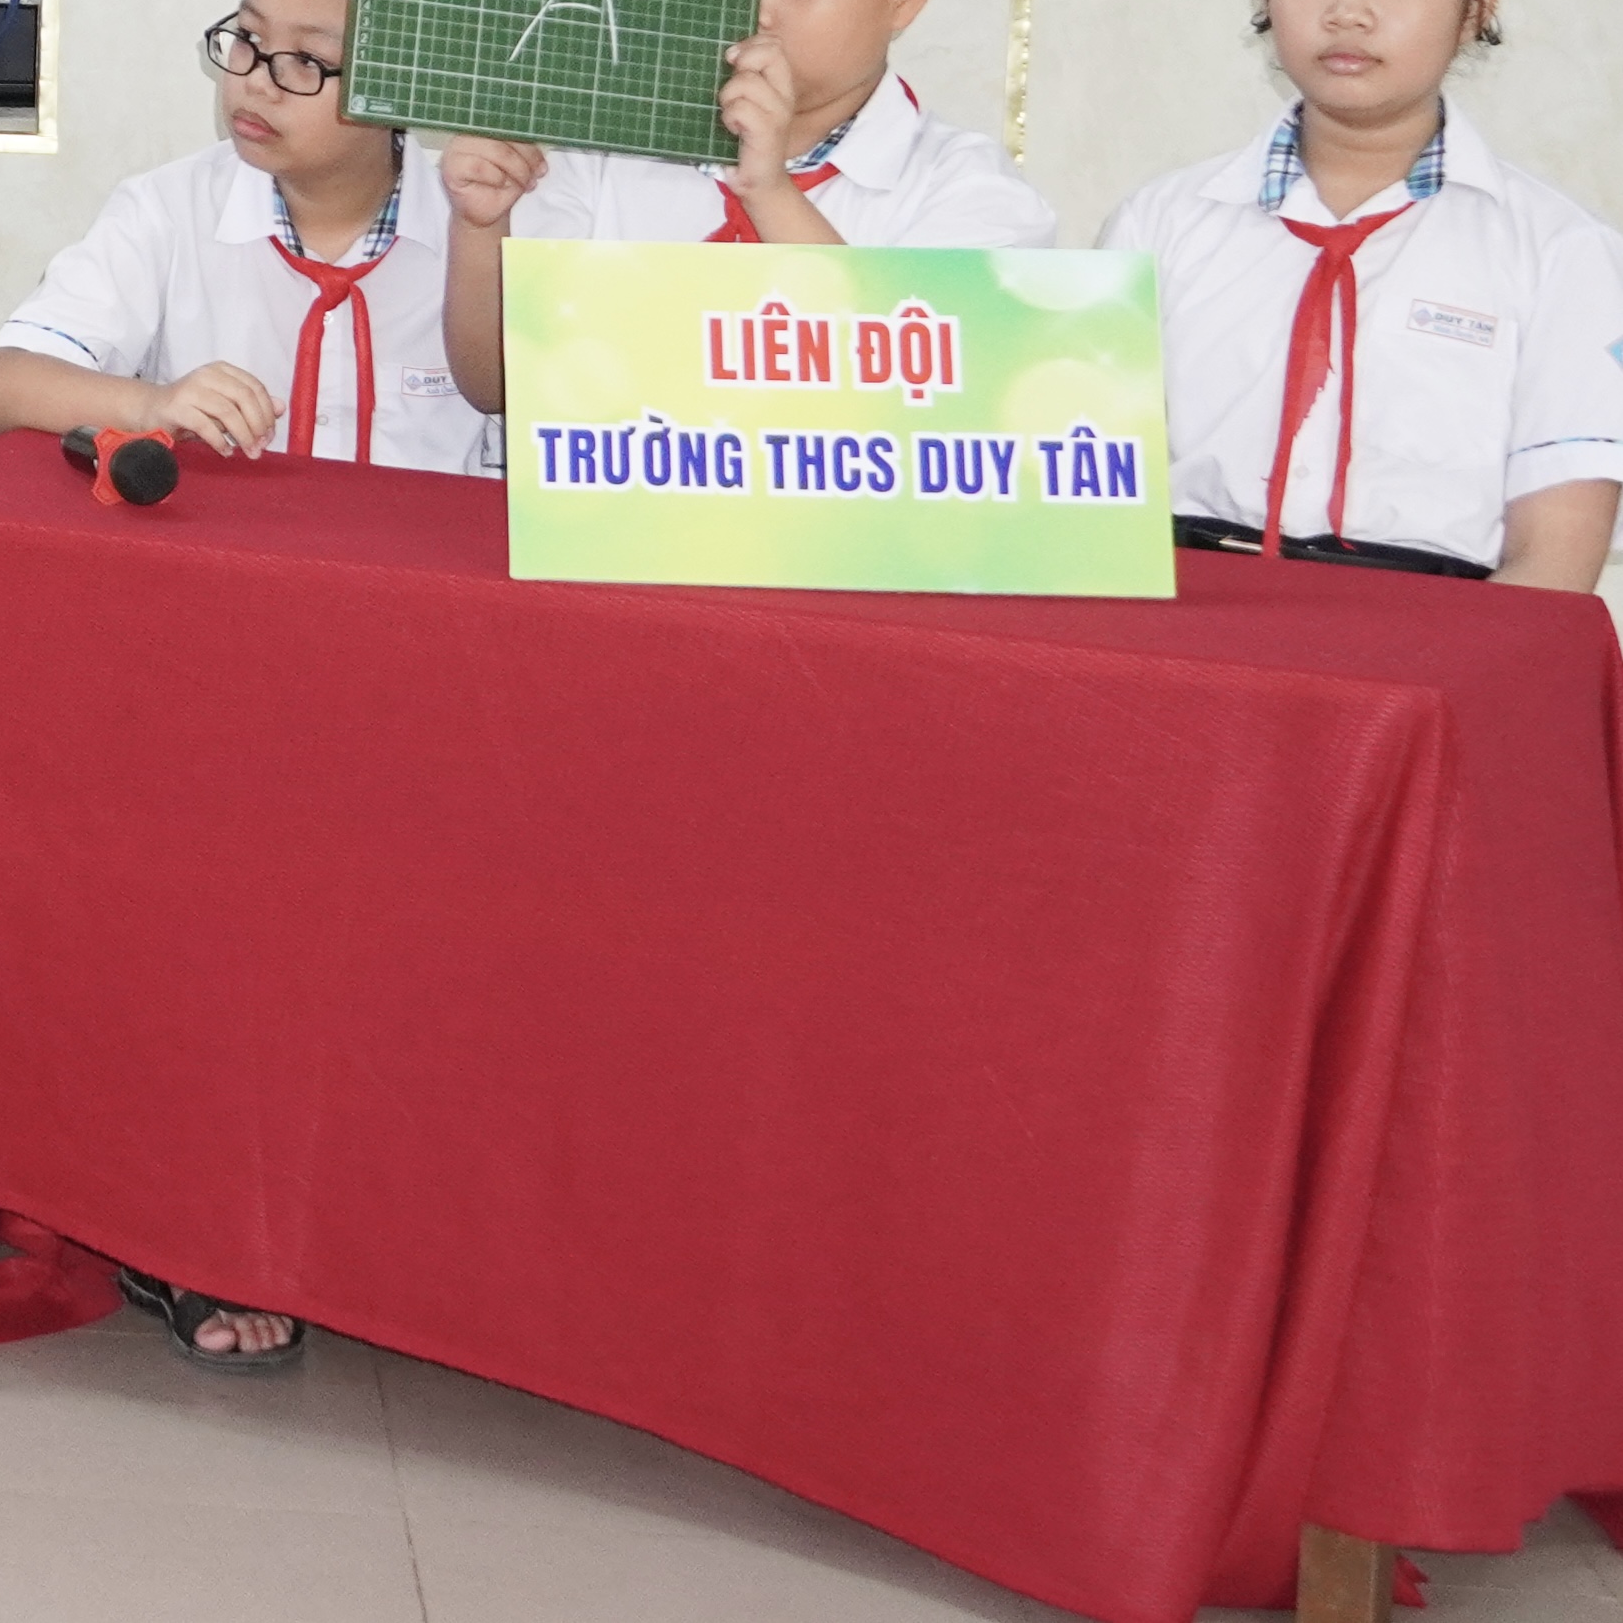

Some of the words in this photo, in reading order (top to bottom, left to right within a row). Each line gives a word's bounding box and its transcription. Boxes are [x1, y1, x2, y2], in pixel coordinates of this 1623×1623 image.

[709, 301, 831, 383] LIÊN
[856, 306, 957, 400] ĐỘI
[536, 415, 744, 488] TRƯỜNG
[765, 433, 895, 493] THCS
[918, 437, 1017, 496] DUY
[1039, 426, 1137, 498] TÂN
